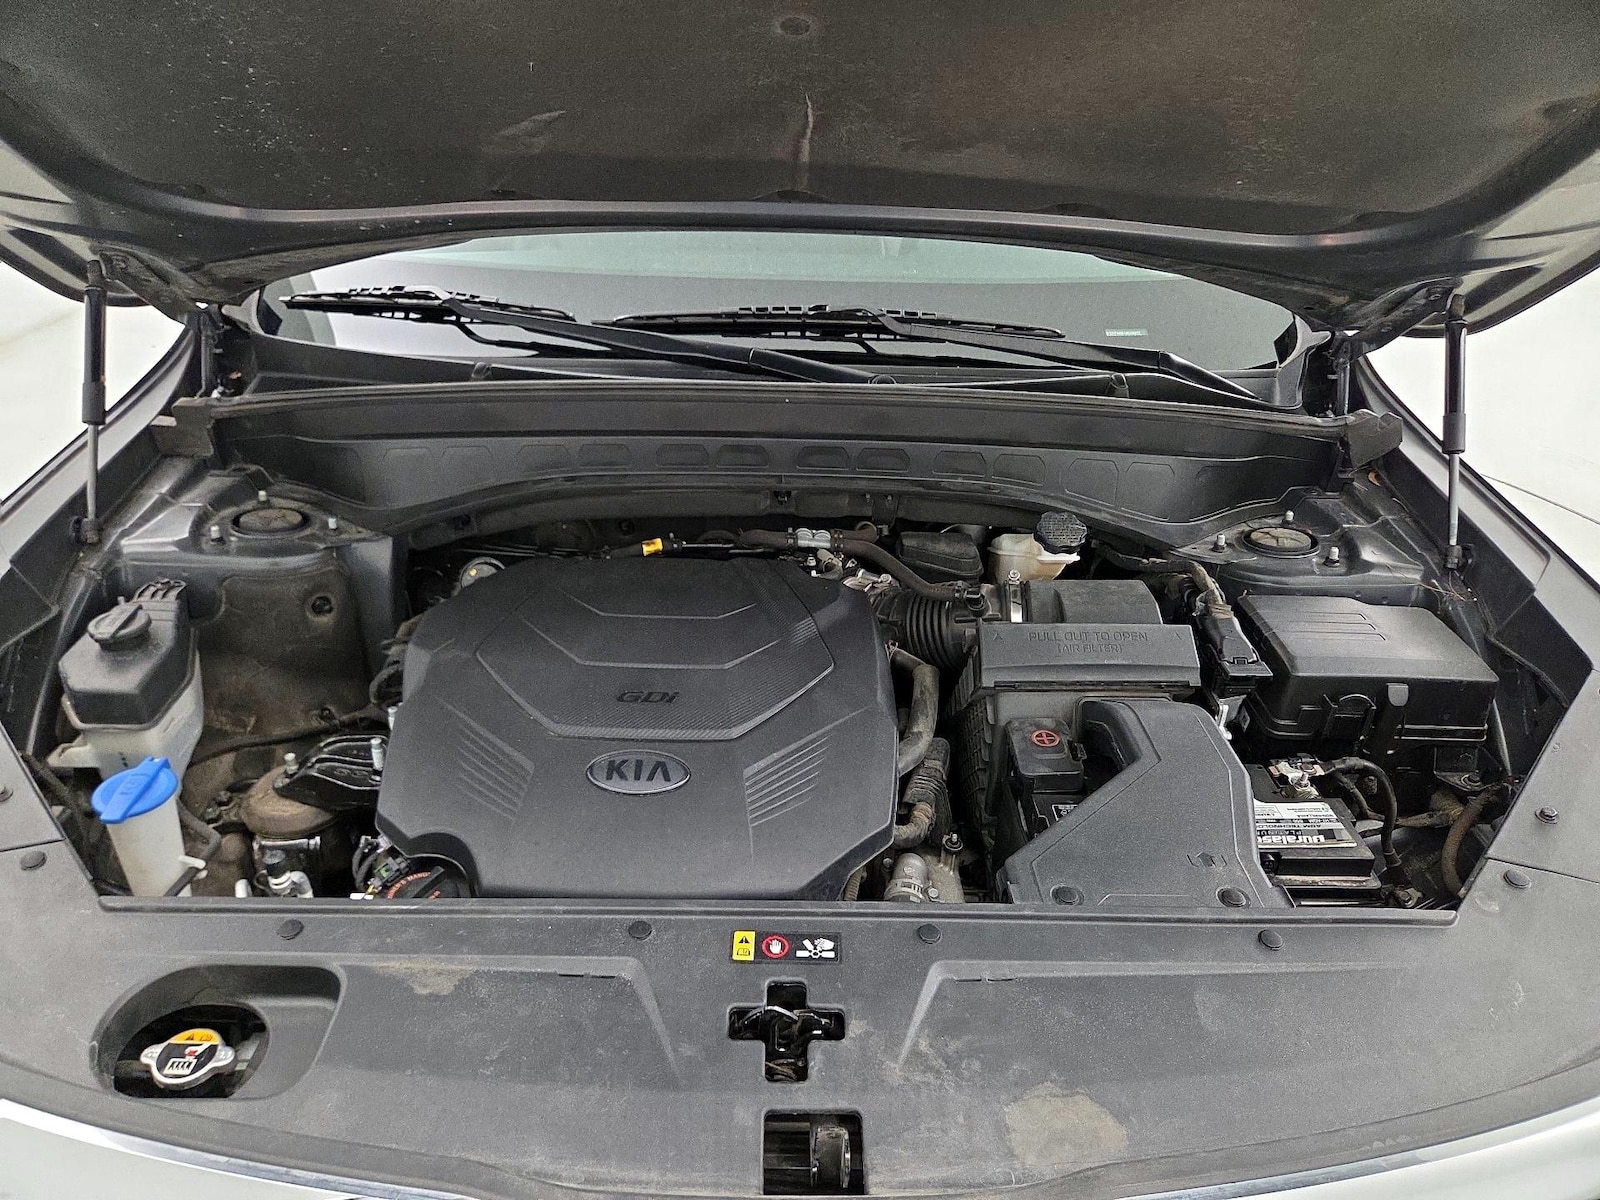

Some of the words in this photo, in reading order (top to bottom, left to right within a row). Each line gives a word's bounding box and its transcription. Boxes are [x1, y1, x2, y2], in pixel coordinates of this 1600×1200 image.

[1028, 631, 1059, 642] PULL
[1064, 631, 1089, 642] OUT
[1094, 631, 1110, 642] TO
[1113, 631, 1148, 642] OPEN
[605, 759, 672, 782] KIA
